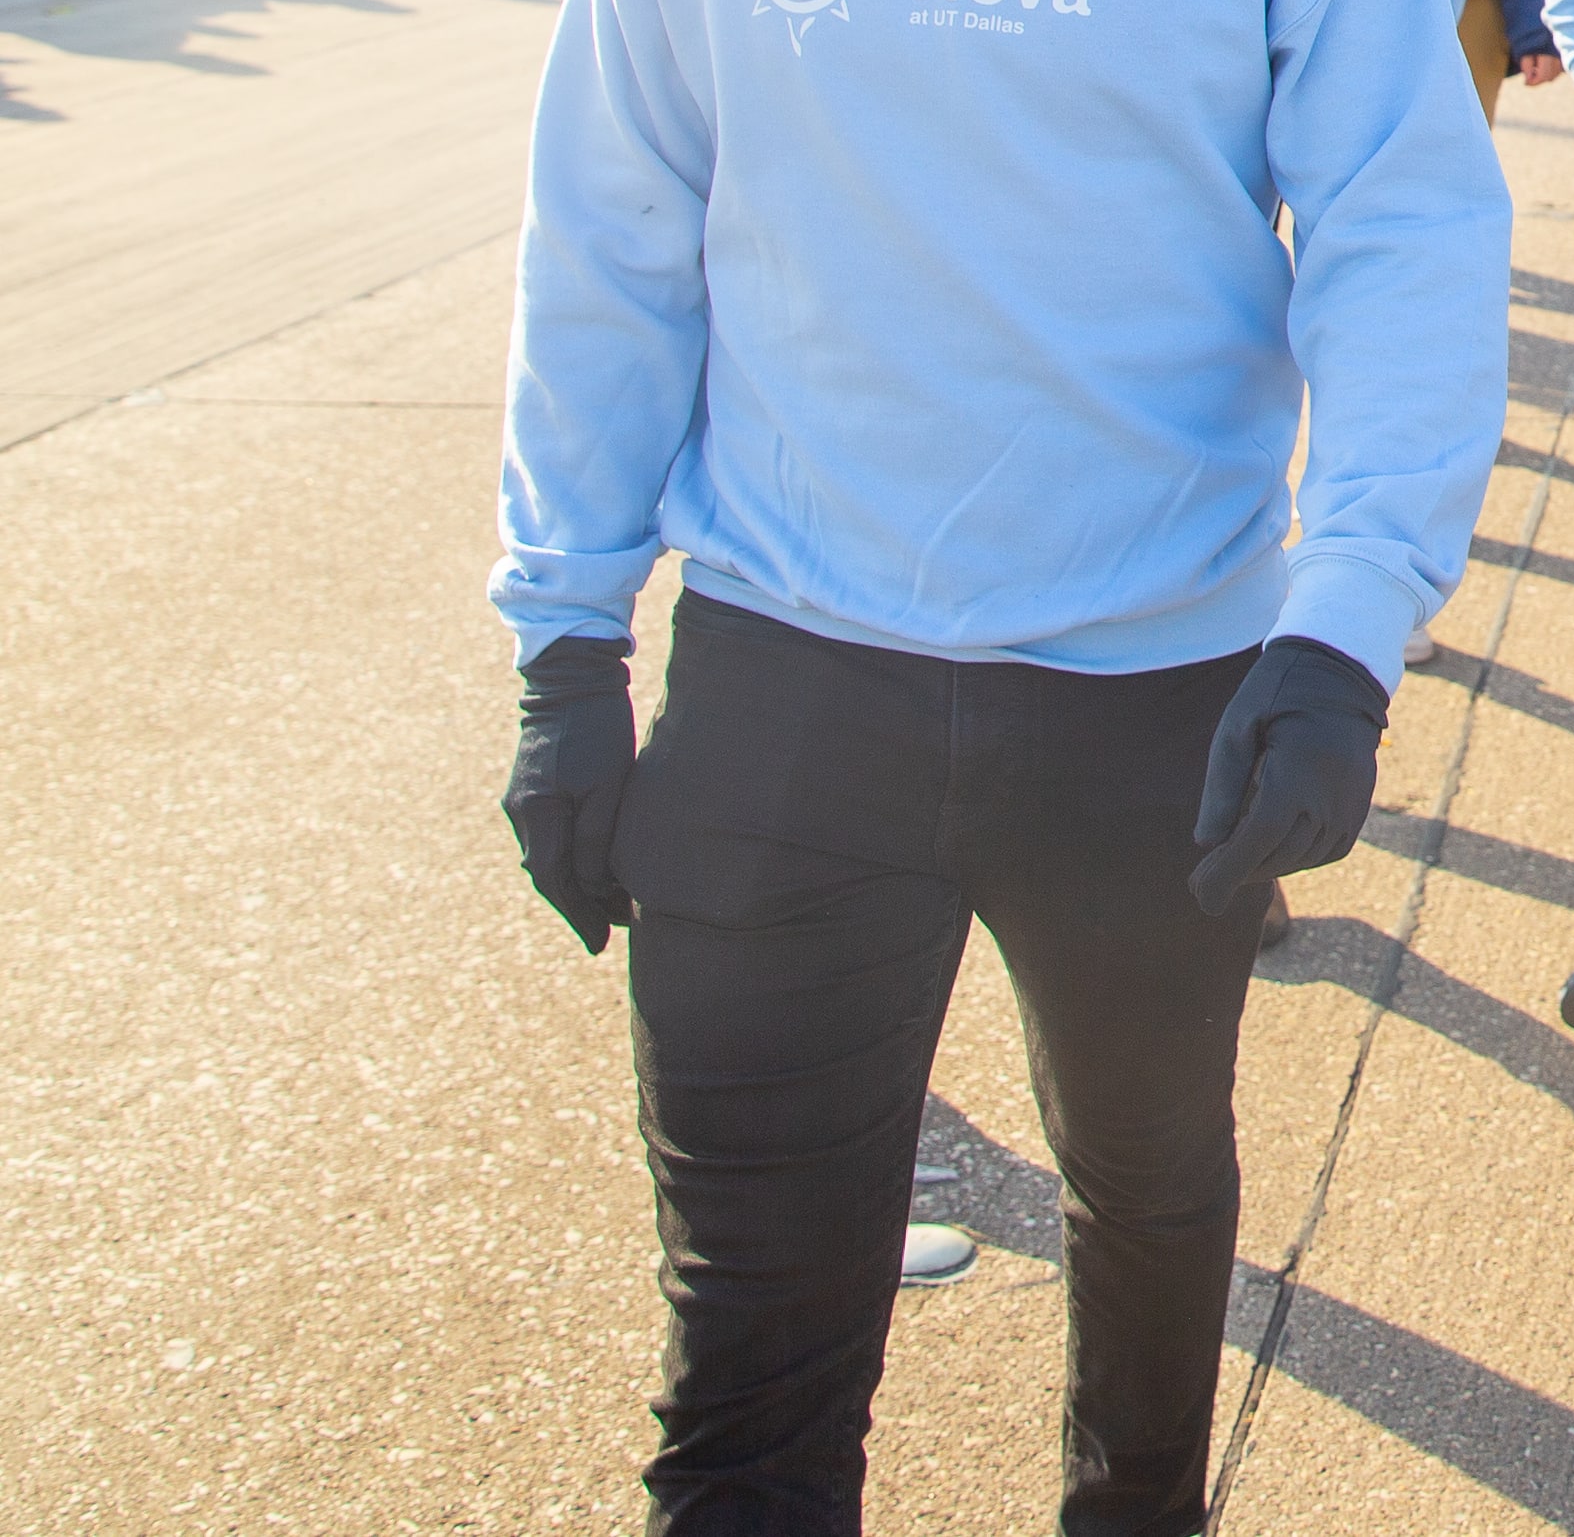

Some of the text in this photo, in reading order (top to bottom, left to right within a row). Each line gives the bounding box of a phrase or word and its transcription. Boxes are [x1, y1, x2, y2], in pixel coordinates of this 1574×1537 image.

[909, 9, 1025, 35] at UT Dallas
